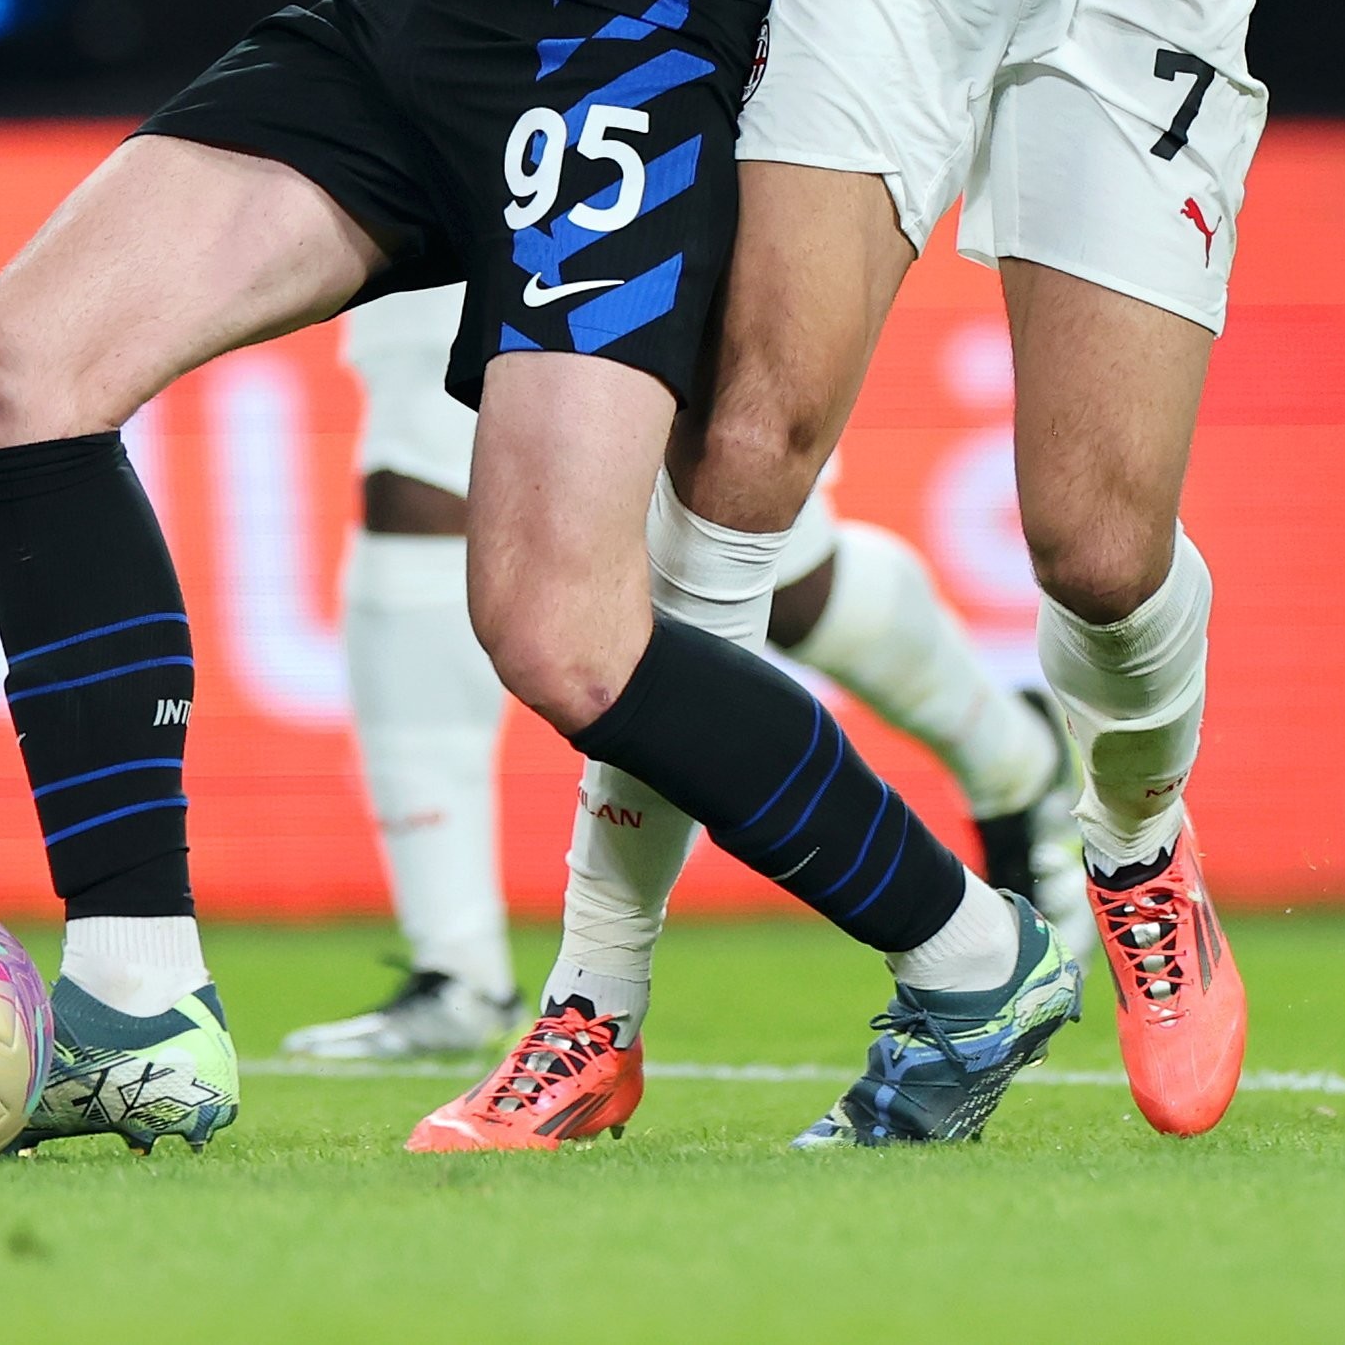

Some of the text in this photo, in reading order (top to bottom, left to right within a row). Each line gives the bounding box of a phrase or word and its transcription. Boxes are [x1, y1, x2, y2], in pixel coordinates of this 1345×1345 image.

[1149, 48, 1217, 162] 7
[503, 103, 650, 232] 95
[153, 699, 192, 727] INT
